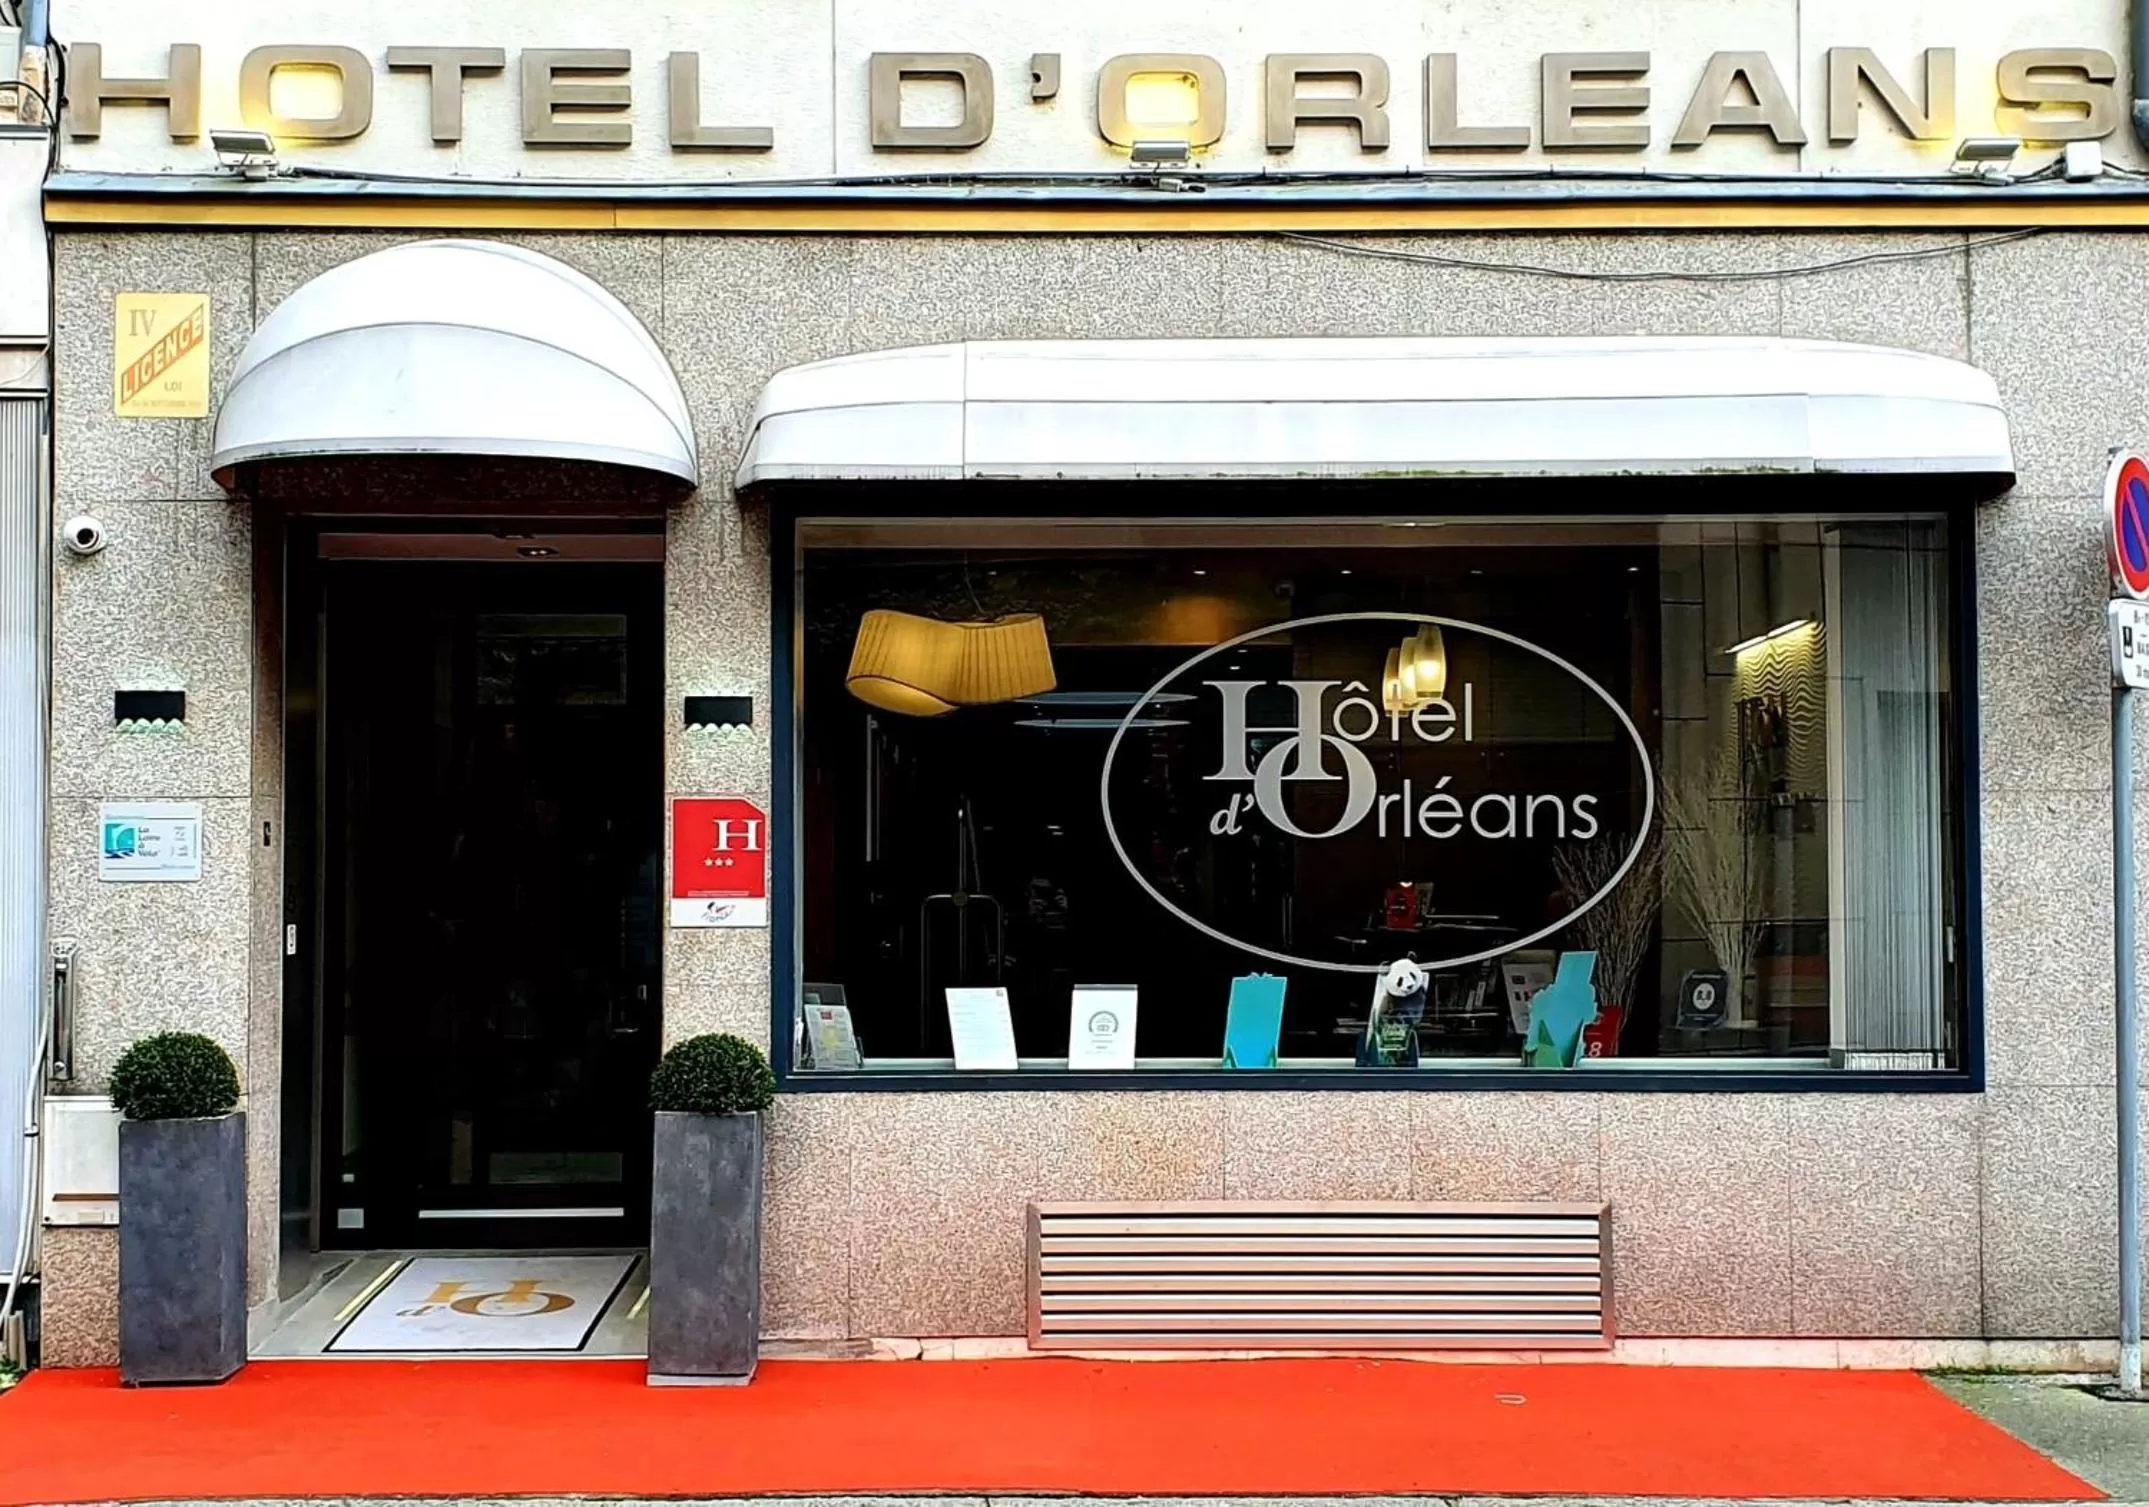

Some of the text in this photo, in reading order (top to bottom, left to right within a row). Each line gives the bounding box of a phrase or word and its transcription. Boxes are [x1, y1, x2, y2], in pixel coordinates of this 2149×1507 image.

[69, 42, 2118, 151] HOTEL D'ORLEANS
[121, 303, 204, 405] LICENCE
[128, 308, 157, 337] IV
[1202, 679, 1474, 781] Hôtel
[712, 818, 763, 852] H
